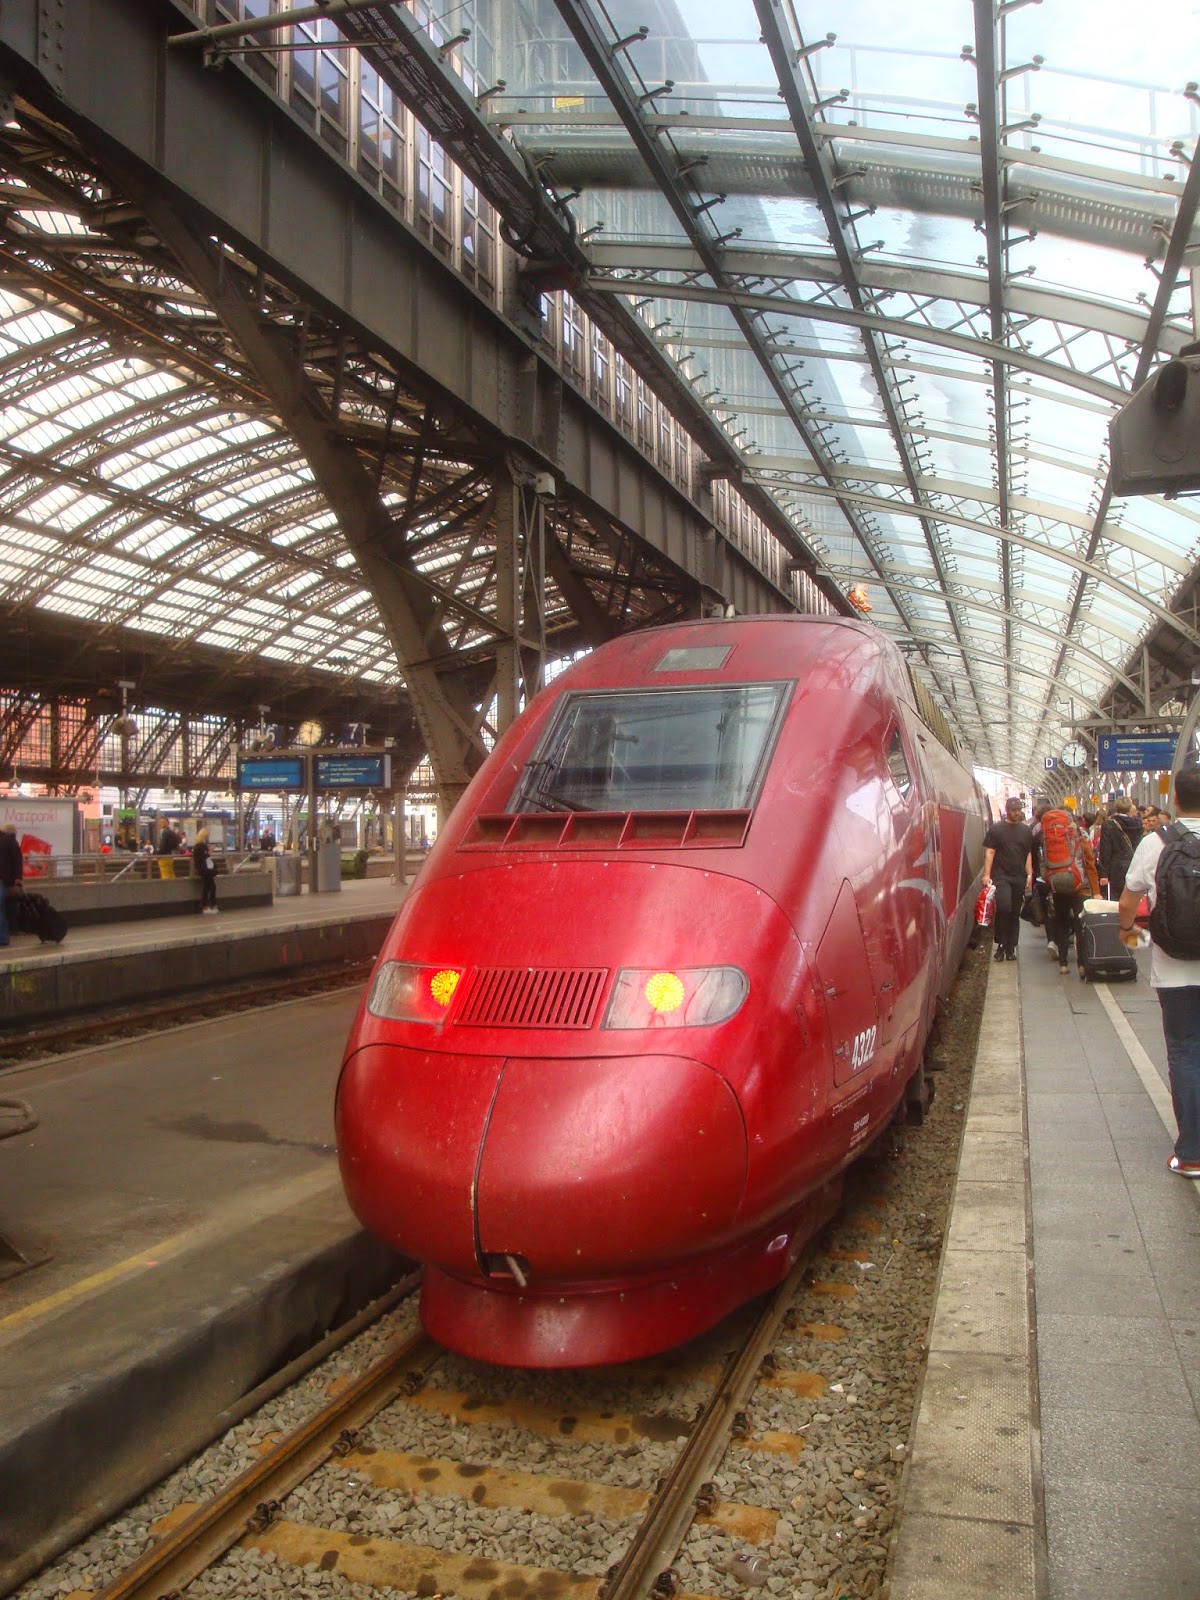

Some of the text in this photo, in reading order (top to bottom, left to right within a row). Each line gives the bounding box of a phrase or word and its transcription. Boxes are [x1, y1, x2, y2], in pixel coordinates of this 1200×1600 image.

[266, 727, 275, 743] 6
[349, 723, 358, 740] 7
[1103, 740, 1110, 750] 8
[240, 763, 246, 772] 6
[375, 759, 381, 768] 7
[1045, 758, 1053, 768] D
[851, 1024, 877, 1070] 4322
